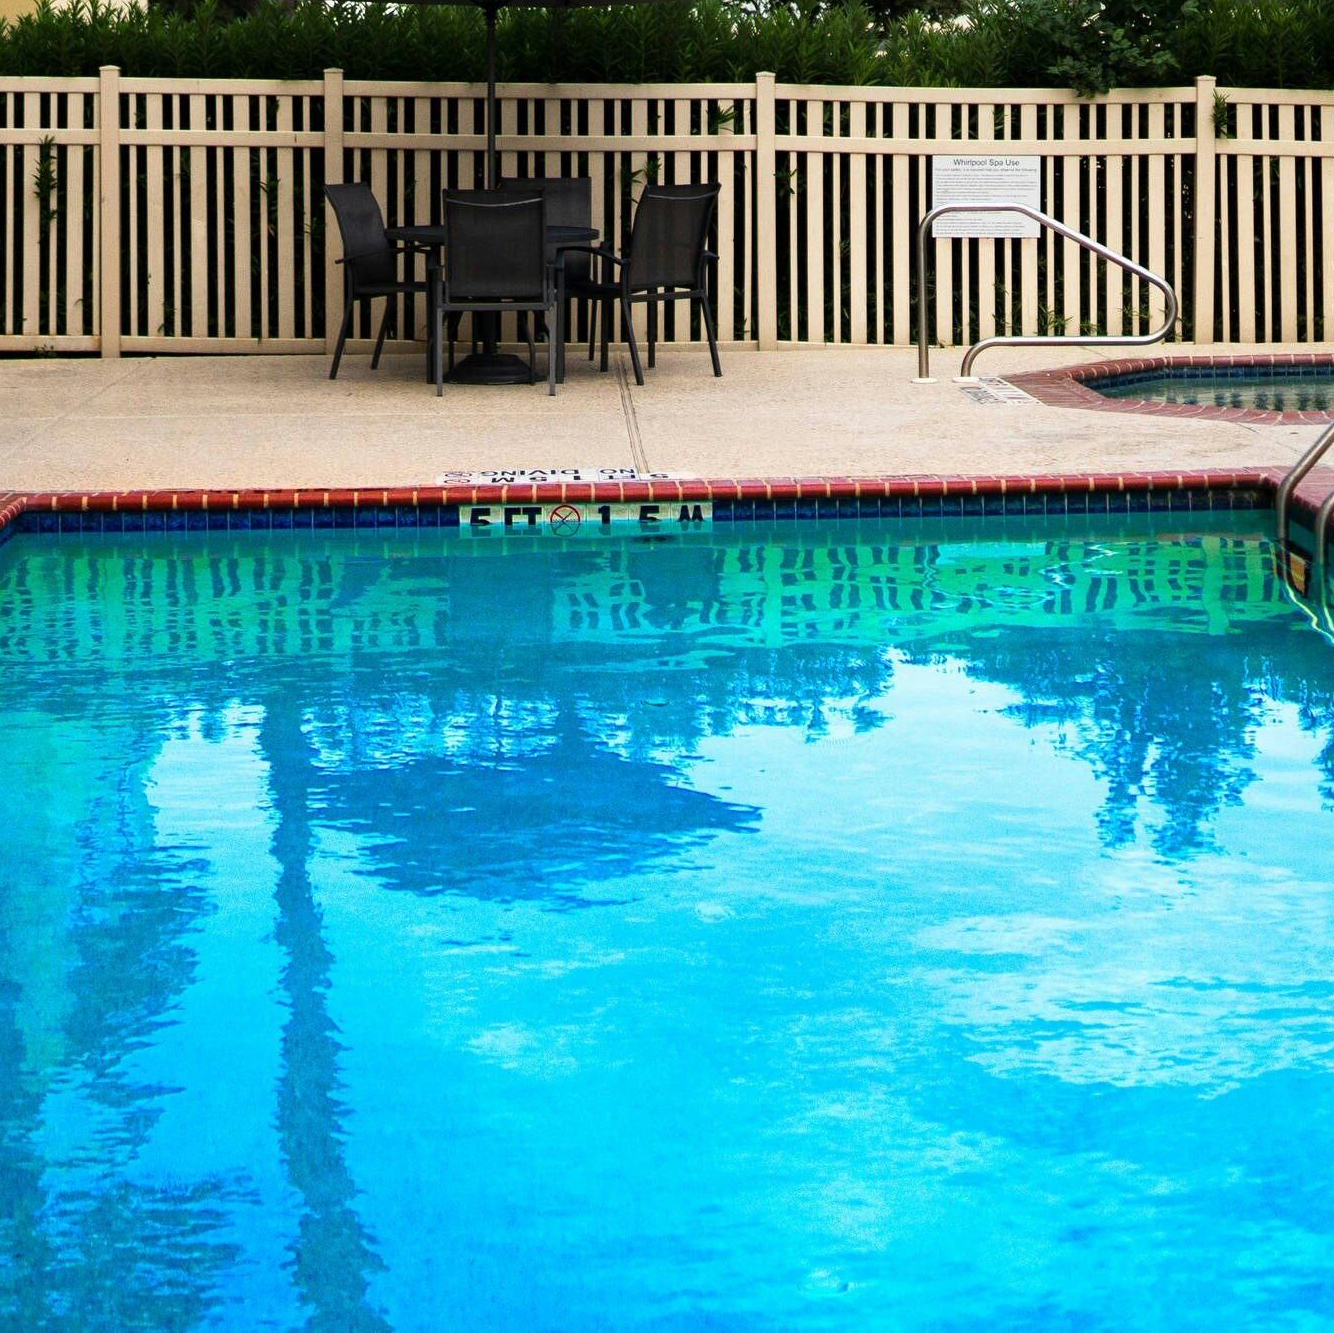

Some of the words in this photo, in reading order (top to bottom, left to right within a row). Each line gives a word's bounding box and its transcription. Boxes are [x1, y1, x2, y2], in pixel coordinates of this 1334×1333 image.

[953, 158, 987, 167] Whirlpool
[989, 158, 1004, 167] Spa
[1005, 158, 1020, 166] Use
